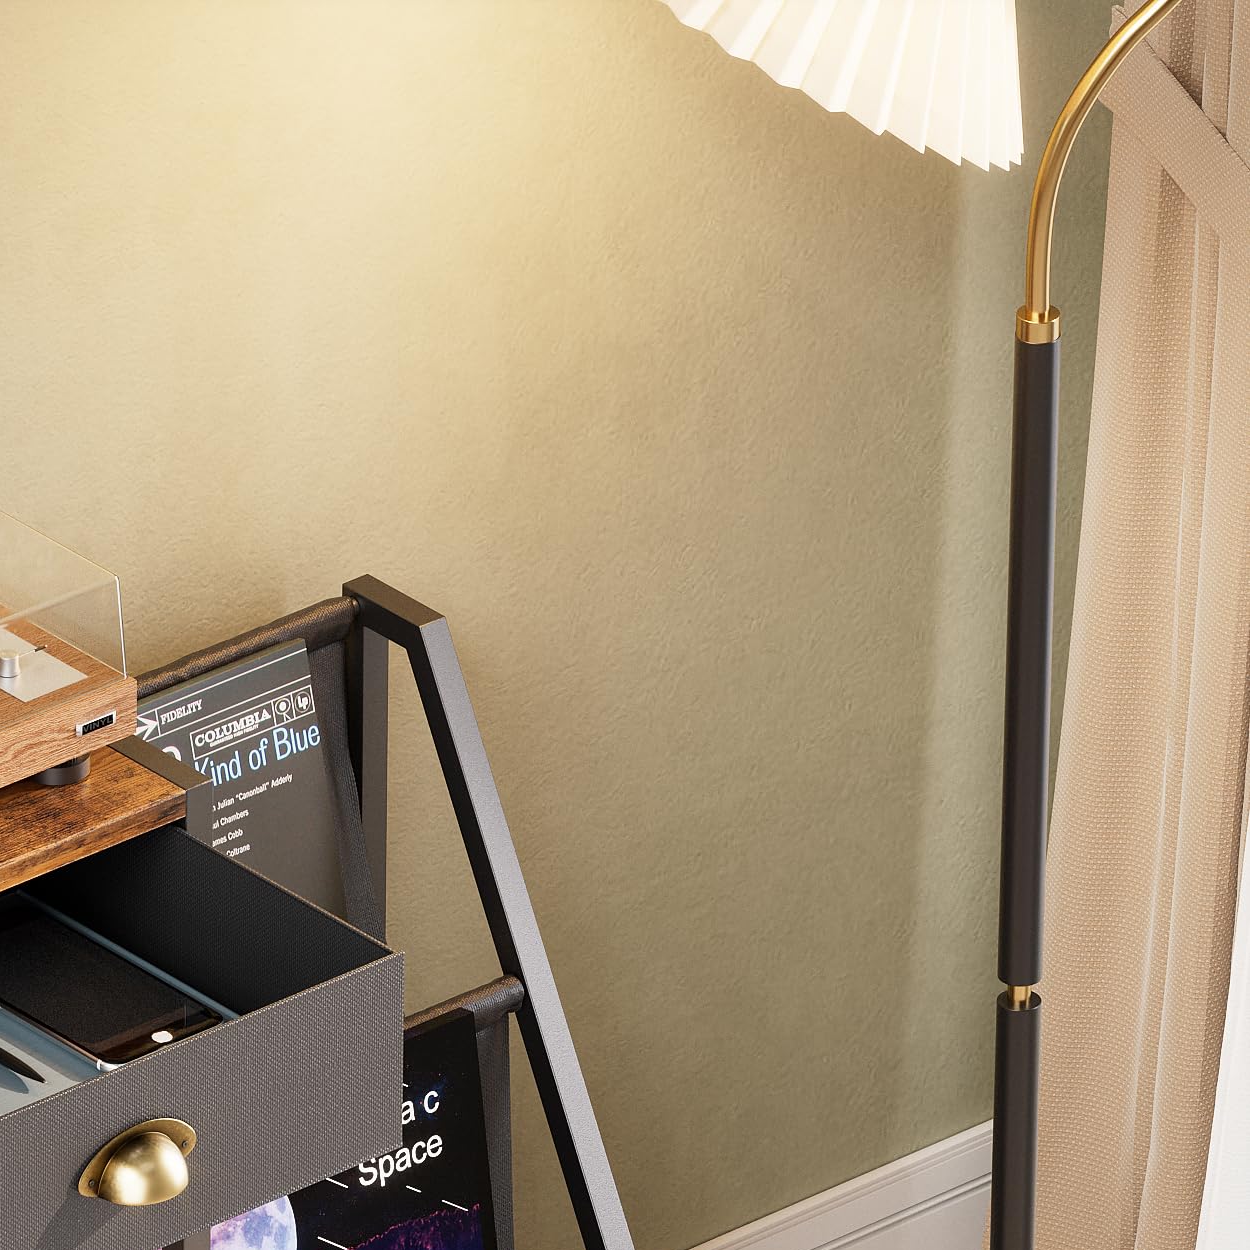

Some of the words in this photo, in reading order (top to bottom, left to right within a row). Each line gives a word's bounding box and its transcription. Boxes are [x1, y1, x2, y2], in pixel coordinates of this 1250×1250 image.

[160, 699, 203, 725] FIDELITY
[84, 717, 112, 732] VINYL
[194, 709, 271, 746] COLUMBIA
[248, 737, 268, 770] of
[272, 725, 321, 761] Blue
[217, 798, 235, 810] Julian
[220, 809, 249, 826] Chambers
[212, 836, 227, 848] ames
[228, 828, 243, 840] Cobb
[358, 1134, 443, 1187] Space
